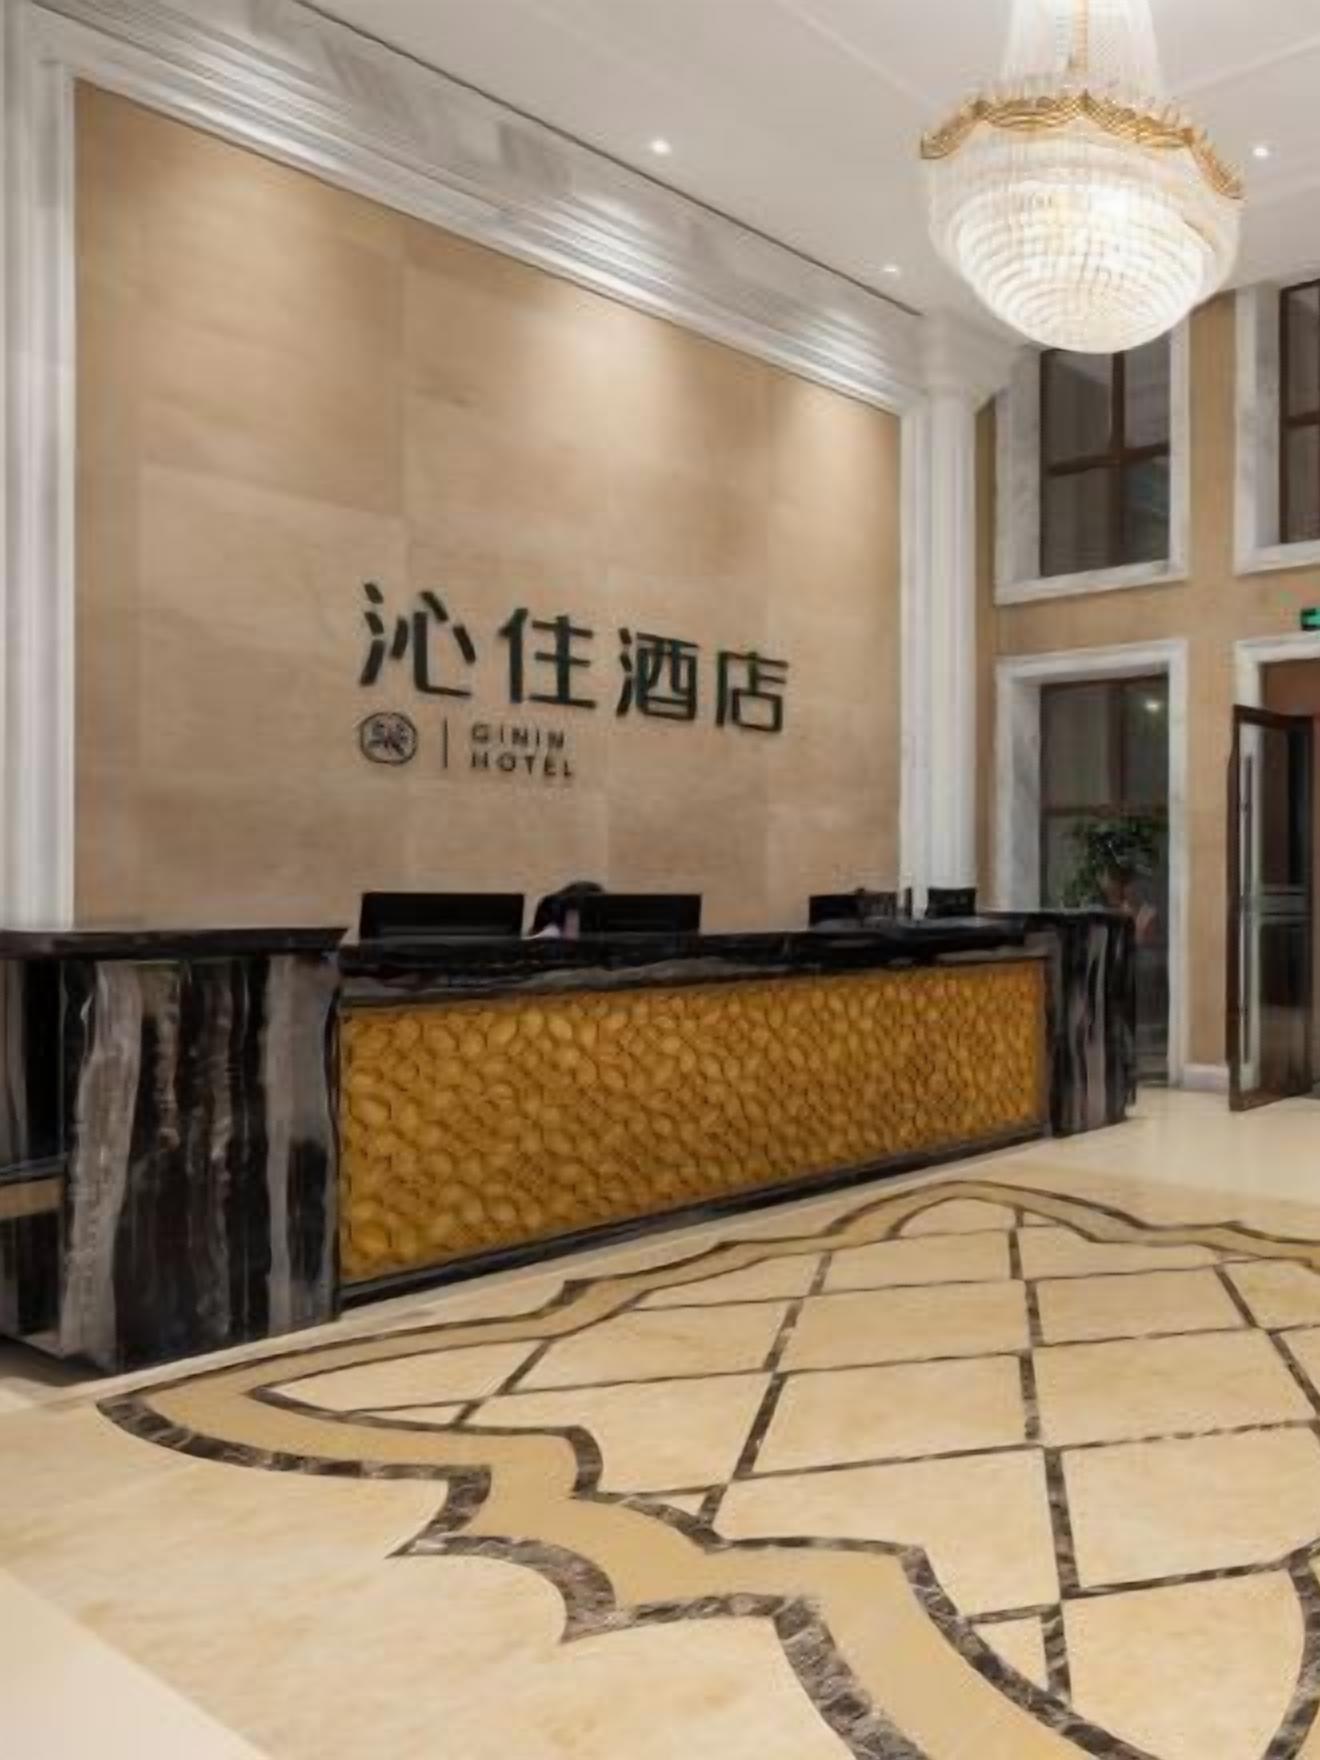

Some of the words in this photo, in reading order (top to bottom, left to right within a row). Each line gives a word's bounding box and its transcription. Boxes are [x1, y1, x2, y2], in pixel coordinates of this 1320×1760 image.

[360, 582, 789, 732] 沁住酒店
[471, 723, 565, 750] GININ
[470, 751, 573, 778] HOTEL
